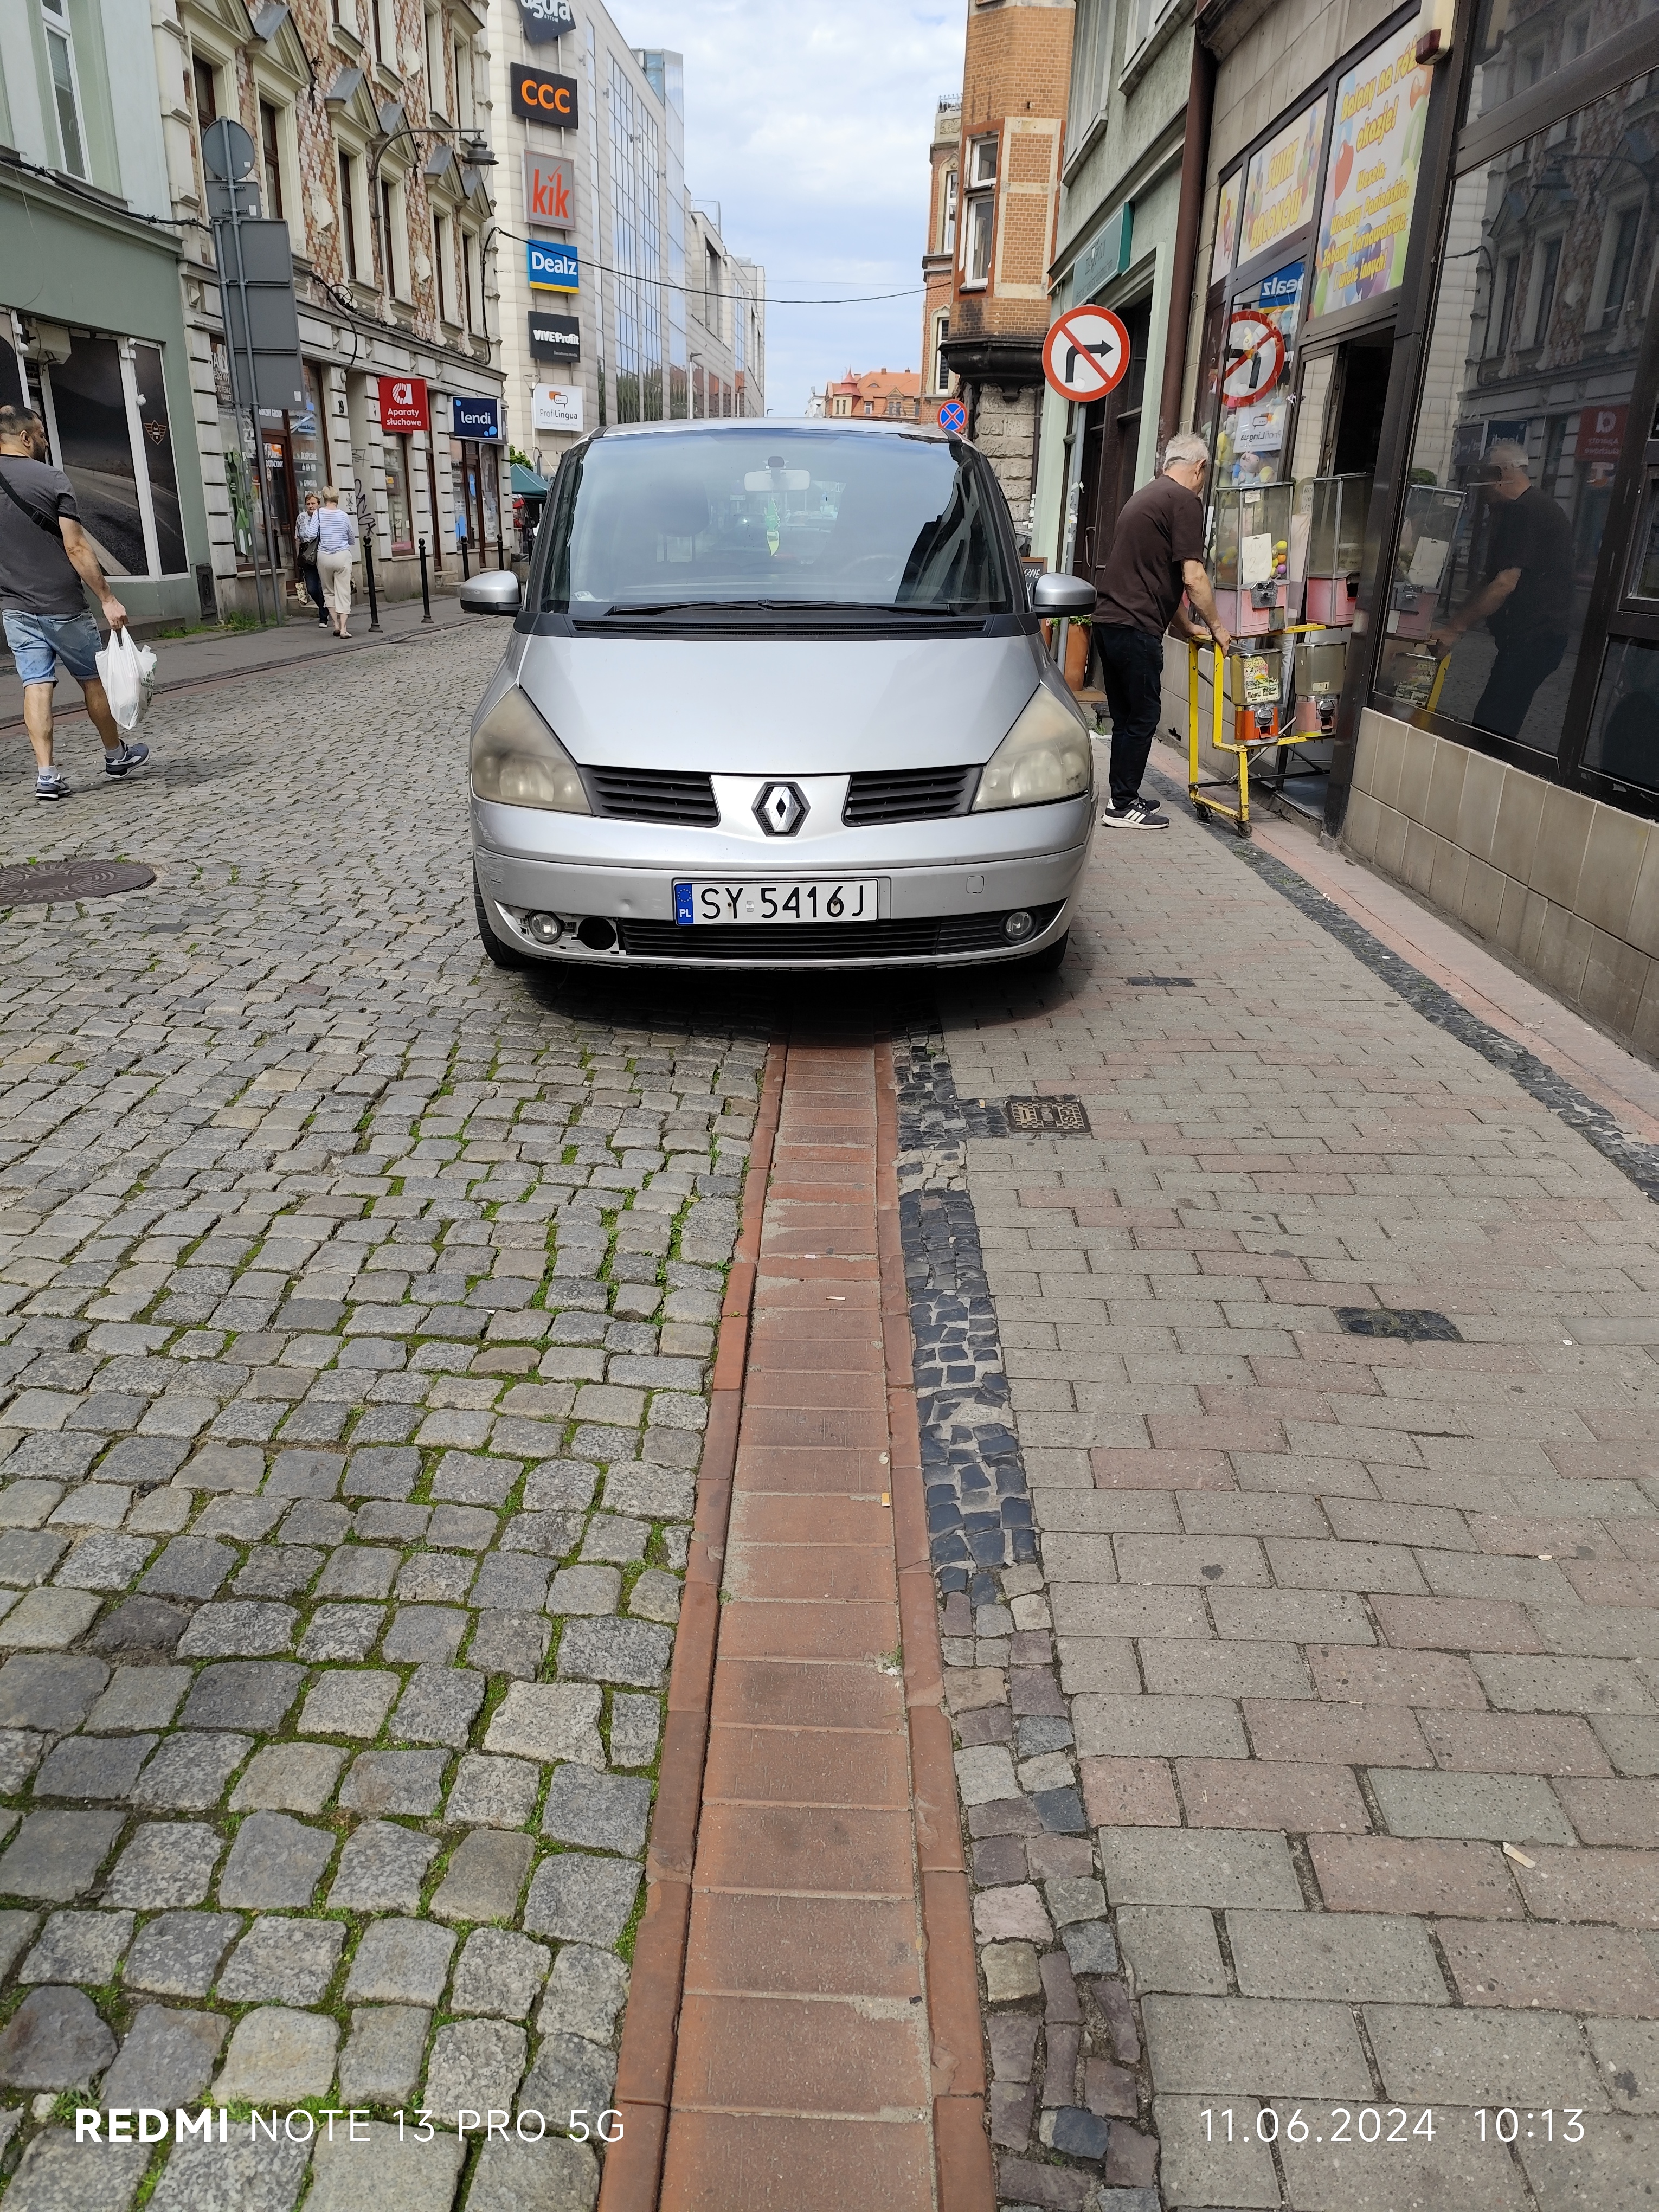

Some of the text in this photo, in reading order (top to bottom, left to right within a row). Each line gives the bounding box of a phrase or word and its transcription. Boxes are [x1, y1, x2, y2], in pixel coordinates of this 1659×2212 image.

[1340, 34, 1418, 125] Balony na róż
[521, 80, 570, 113] CCC
[1356, 94, 1399, 153] okazje!
[1265, 137, 1300, 195] ŚWIAT
[1249, 183, 1303, 252] BALONÓW
[1330, 205, 1363, 236] Wieczory
[531, 251, 577, 275] Dealz
[1322, 241, 1351, 268] Zabawy
[1338, 262, 1359, 290] wiele
[1359, 247, 1388, 281] innych!
[387, 418, 422, 426] słuchowe
[388, 408, 419, 418] Aparaty
[461, 410, 491, 424] lendi
[539, 409, 578, 421] ProfiLingua
[679, 908, 692, 918] PL
[700, 885, 864, 919] SY 5416J
